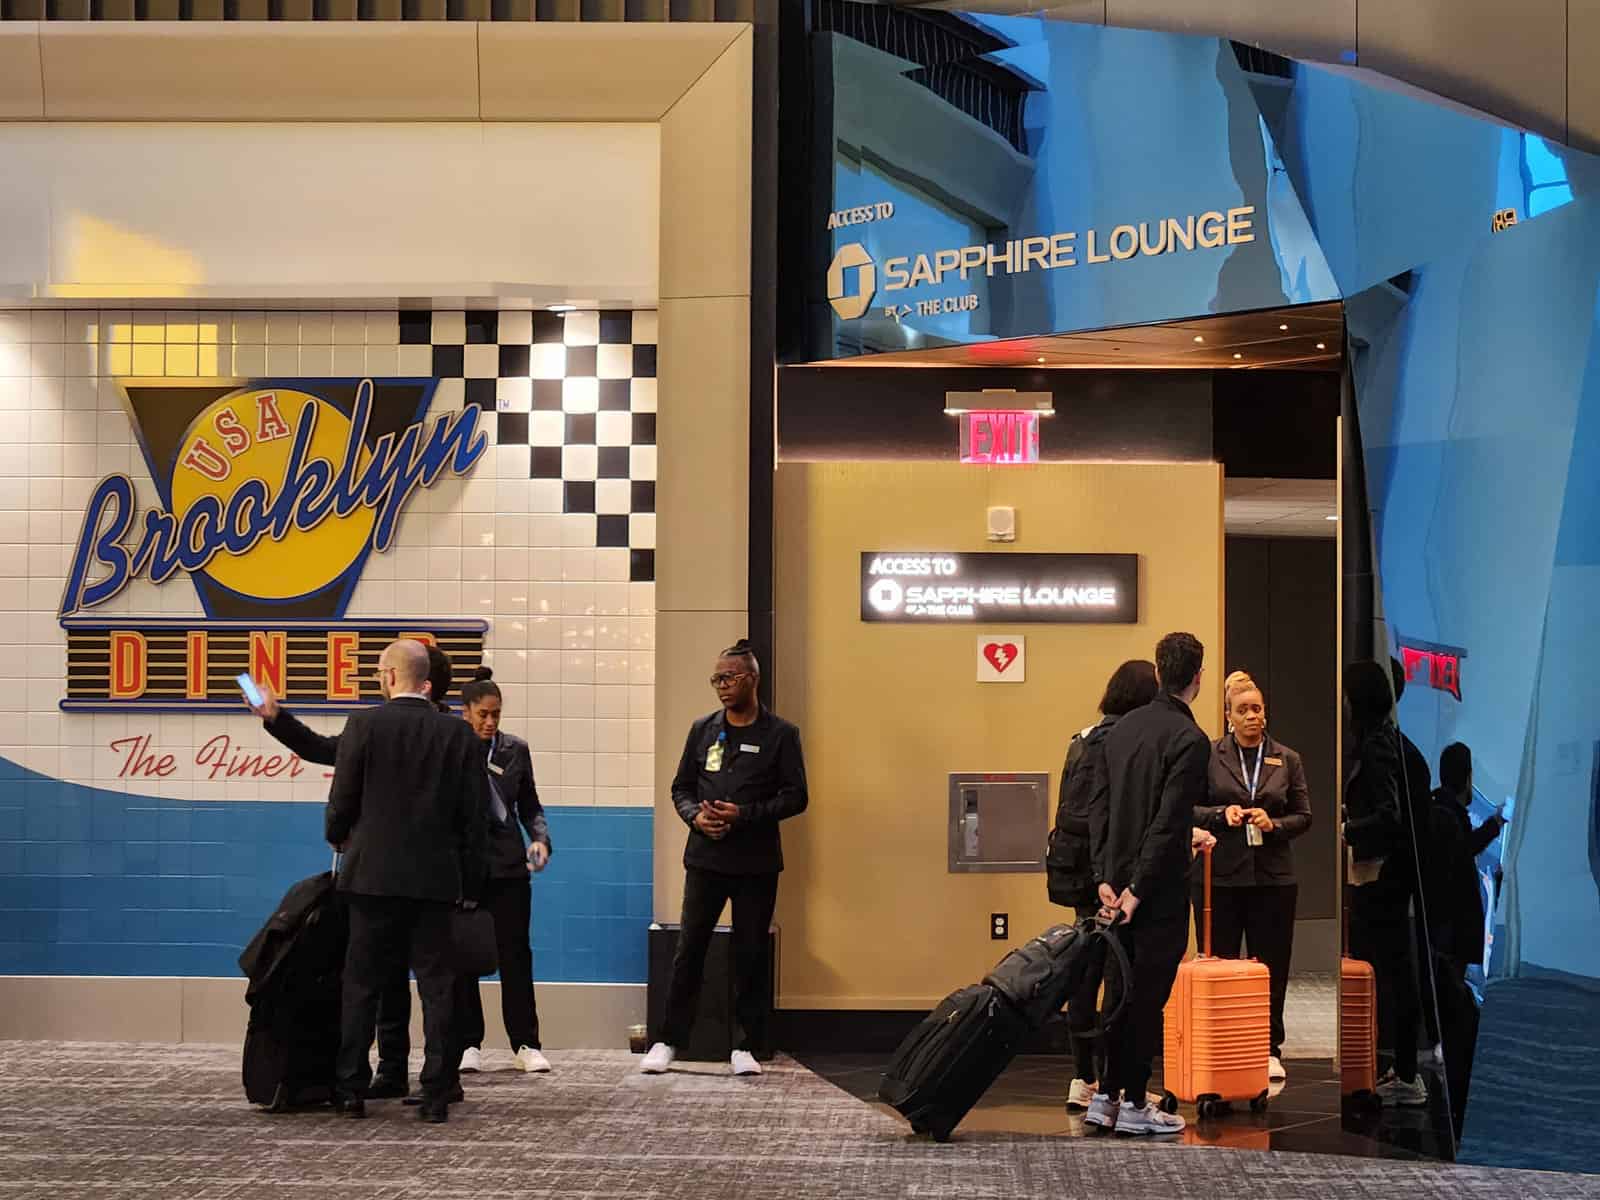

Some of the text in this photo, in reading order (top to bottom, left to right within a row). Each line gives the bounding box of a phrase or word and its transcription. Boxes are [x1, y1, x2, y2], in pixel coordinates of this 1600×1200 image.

[827, 202, 894, 230] ACCESS TO
[884, 206, 1255, 290] SAPPHIRE LOUNGE
[917, 299, 941, 316] THE
[944, 294, 978, 312] CLUB
[183, 391, 291, 481] USA
[970, 413, 1033, 462] EXIT
[57, 378, 488, 619] Brooklyn
[869, 557, 956, 575] ACCESS TO
[906, 586, 1116, 605] SAPPHIRE LOUNGE
[109, 631, 438, 699] DINE
[110, 733, 305, 779] The Finer
